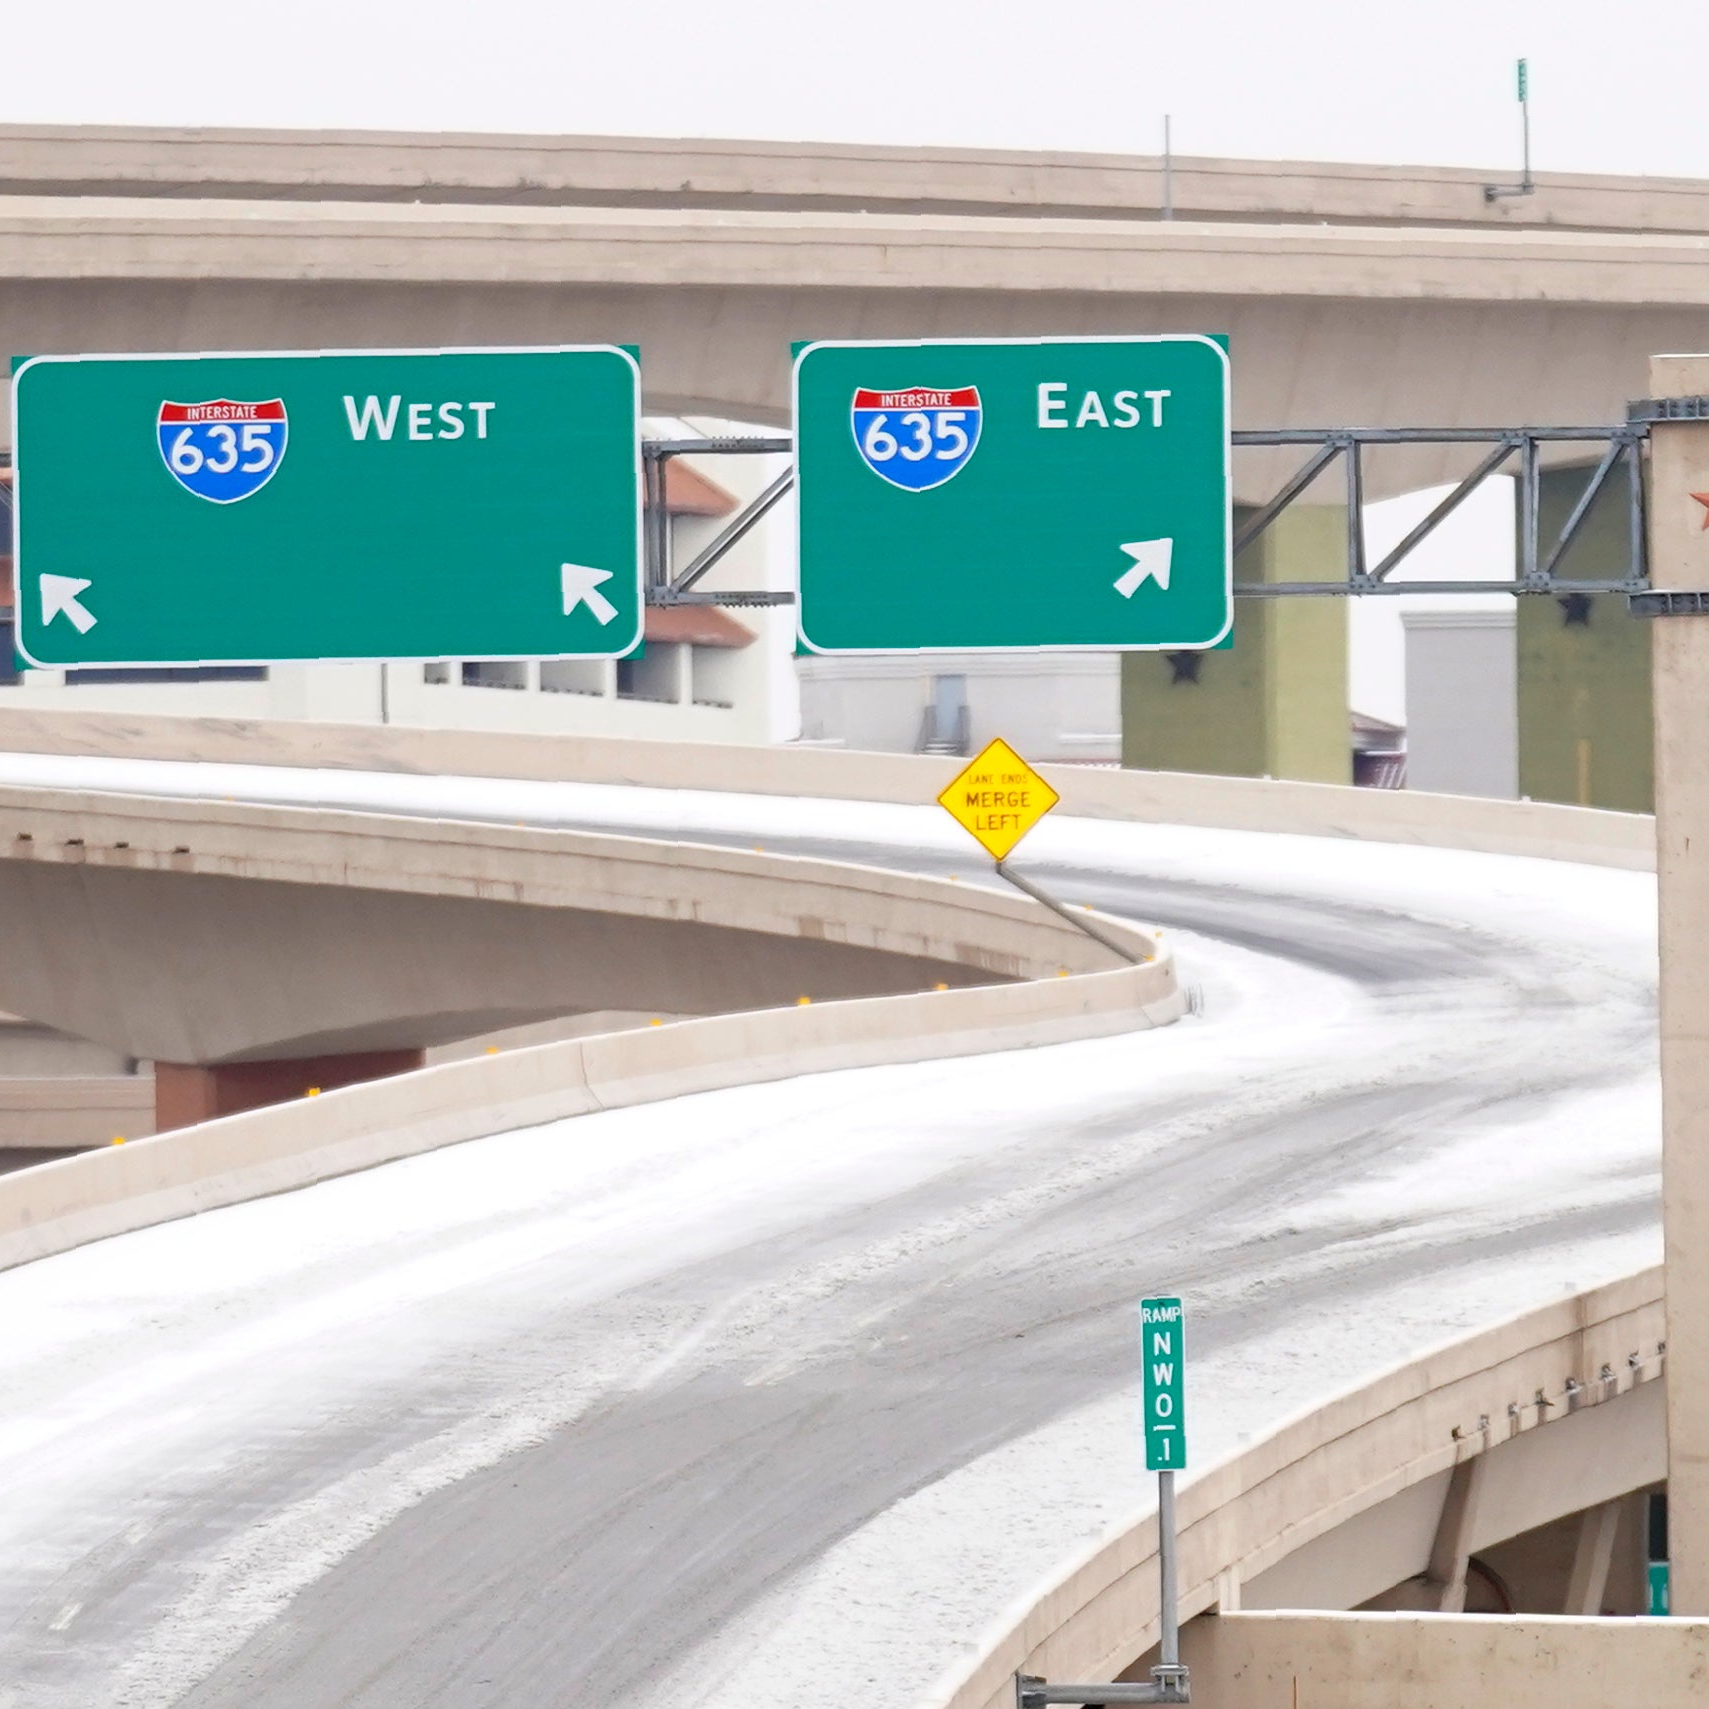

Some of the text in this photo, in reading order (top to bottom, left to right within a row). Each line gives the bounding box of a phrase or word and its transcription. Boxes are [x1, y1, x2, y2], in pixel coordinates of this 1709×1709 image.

[881, 392, 952, 408] INTERSTATE
[1037, 382, 1172, 429] EAST
[186, 404, 258, 421] INTERSTATE
[342, 394, 496, 441] WEST
[864, 411, 970, 462] 635
[170, 423, 275, 475] 635
[968, 773, 1029, 785] LANE ENDS
[966, 791, 1031, 808] MERGE
[976, 814, 1022, 830] LEFT
[1142, 1306, 1181, 1323] RAMP
